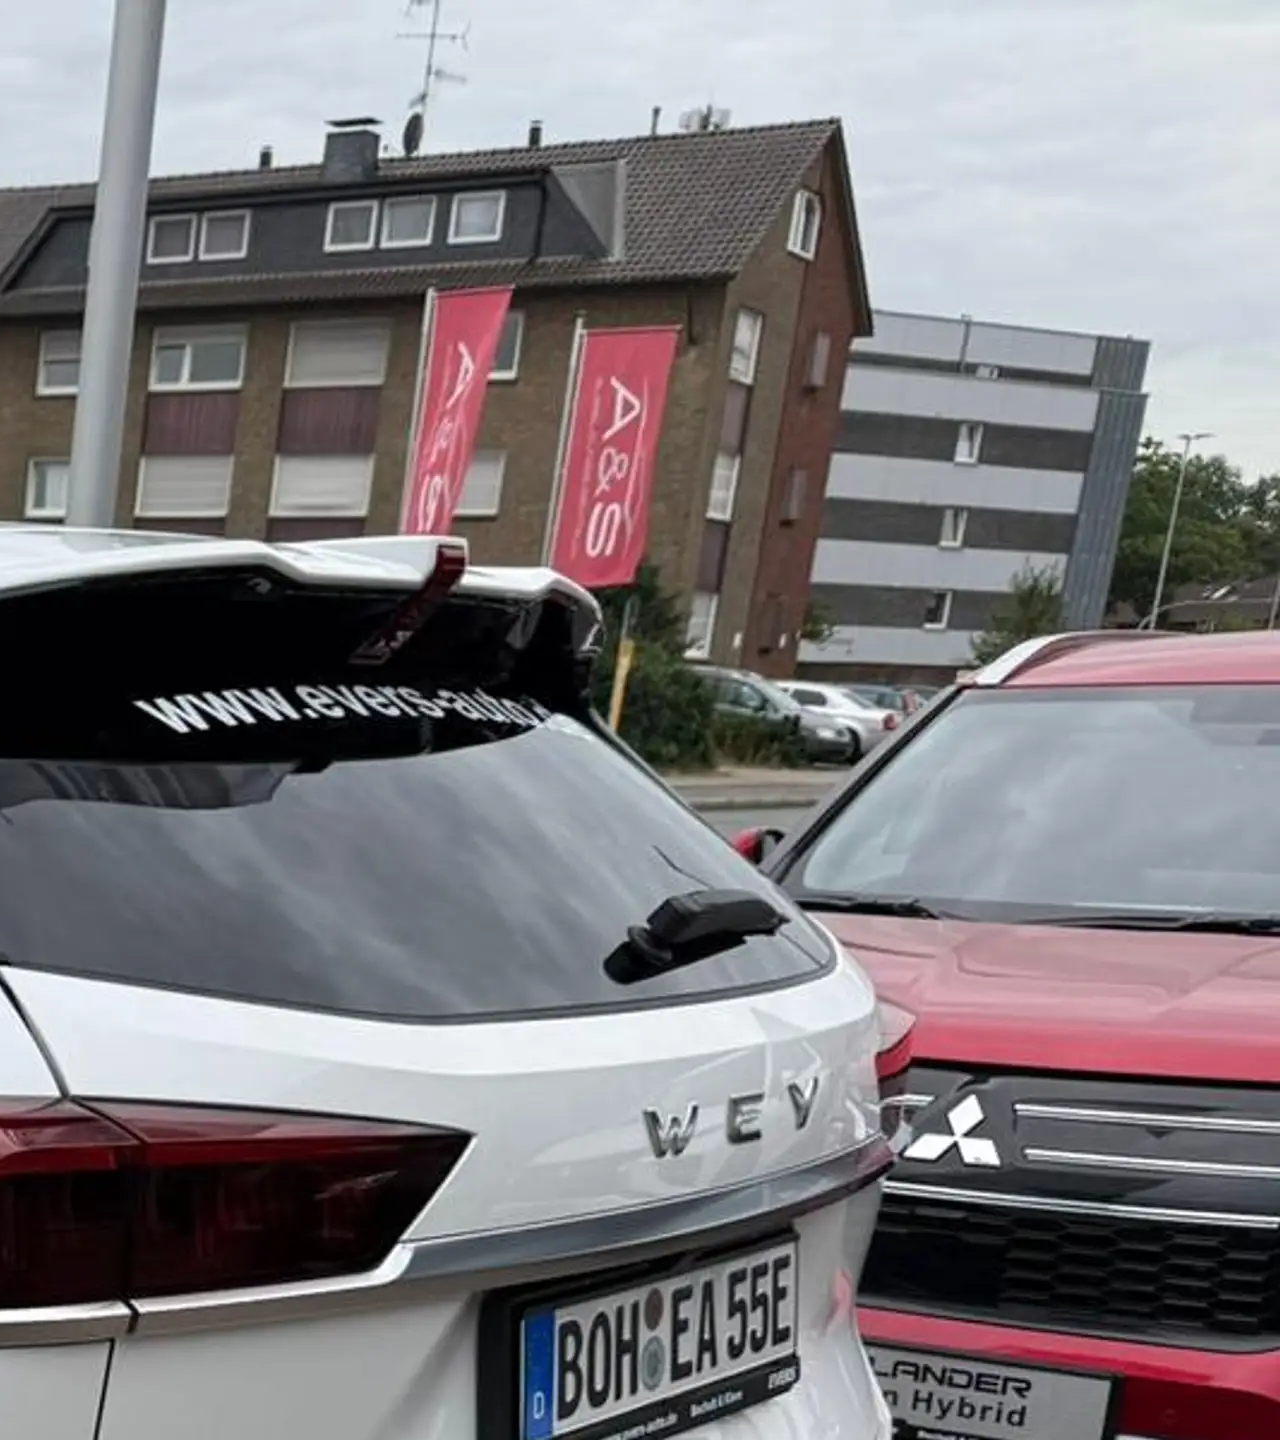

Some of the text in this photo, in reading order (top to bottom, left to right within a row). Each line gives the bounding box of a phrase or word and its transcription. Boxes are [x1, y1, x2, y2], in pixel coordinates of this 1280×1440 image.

[585, 375, 641, 558] A&S
[642, 1075, 819, 1159] WEY
[556, 1253, 791, 1422] BOH EA 55E
[868, 1356, 1033, 1399] LANDER
[912, 1389, 1028, 1428] Hybrid
